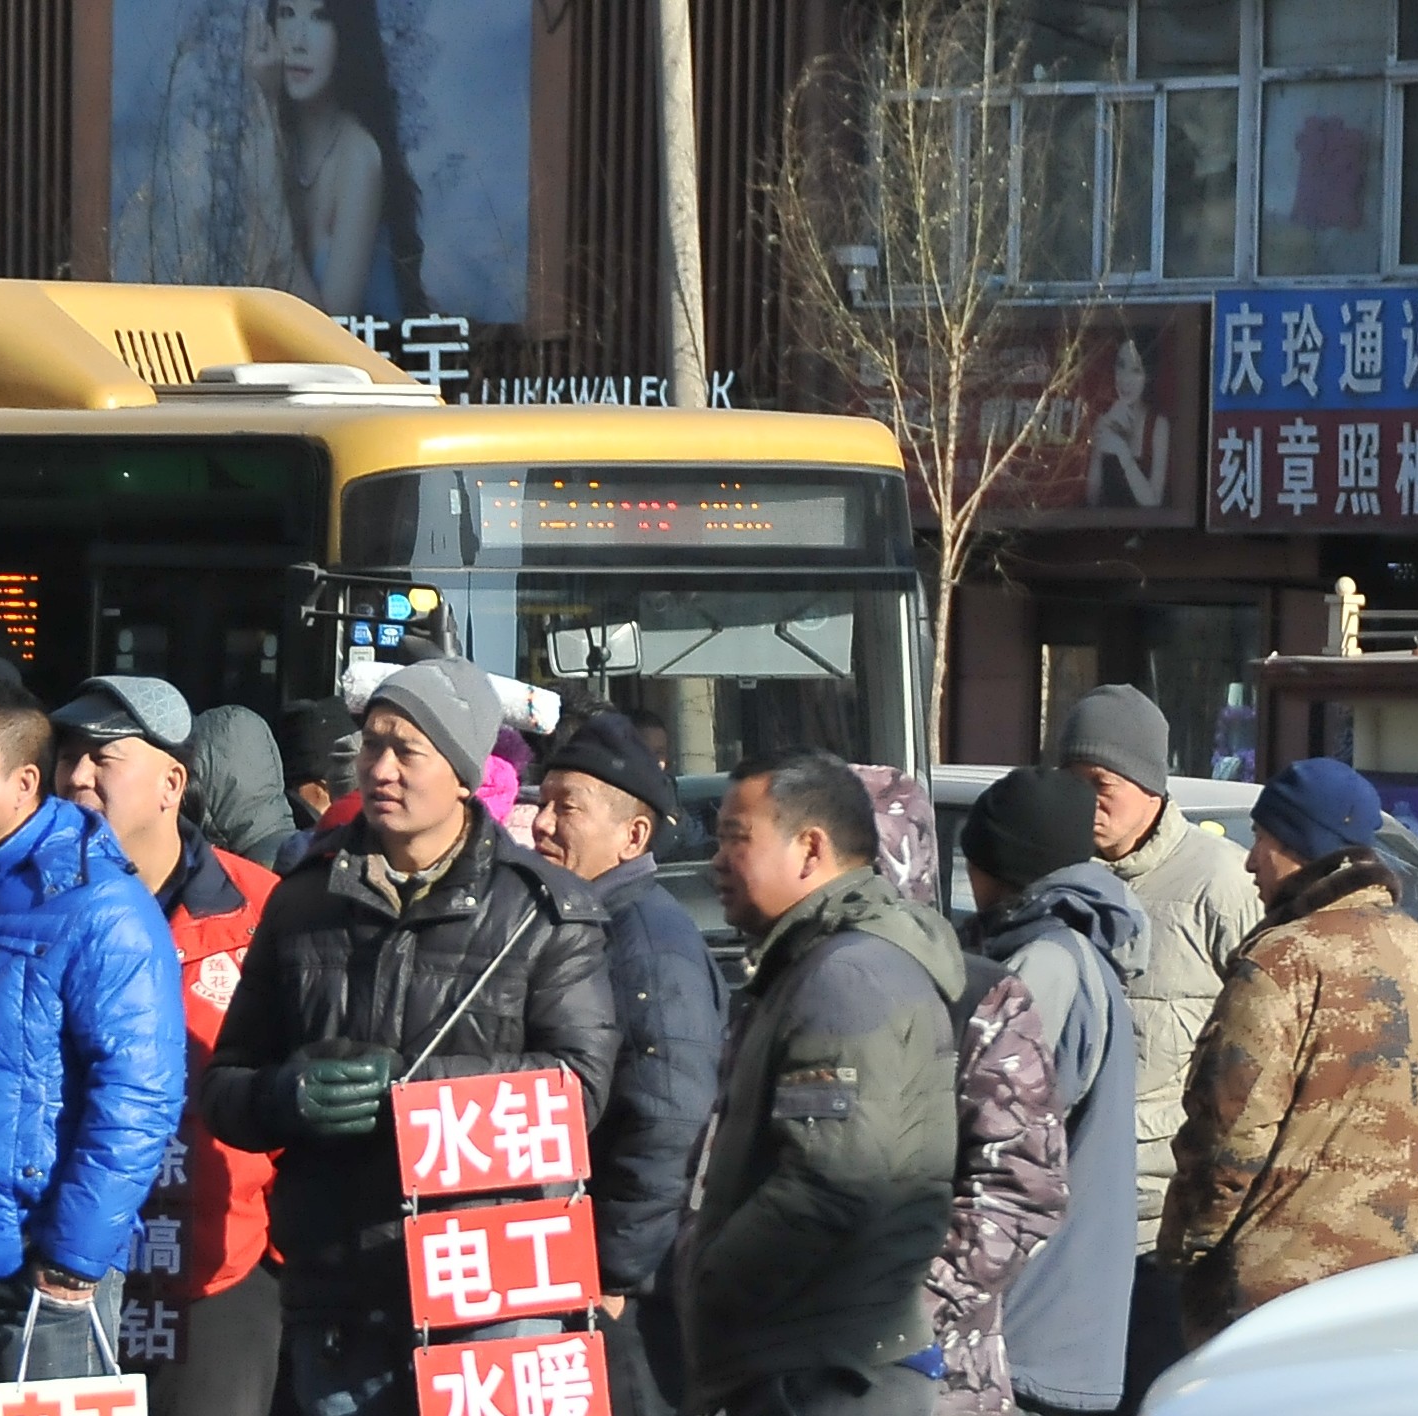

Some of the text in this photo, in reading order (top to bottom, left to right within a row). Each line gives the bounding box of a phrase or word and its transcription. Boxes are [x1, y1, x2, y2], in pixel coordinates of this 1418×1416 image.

[408, 1077, 574, 1186] 水钻
[423, 1215, 581, 1319] 电工
[120, 1298, 179, 1361] 钻
